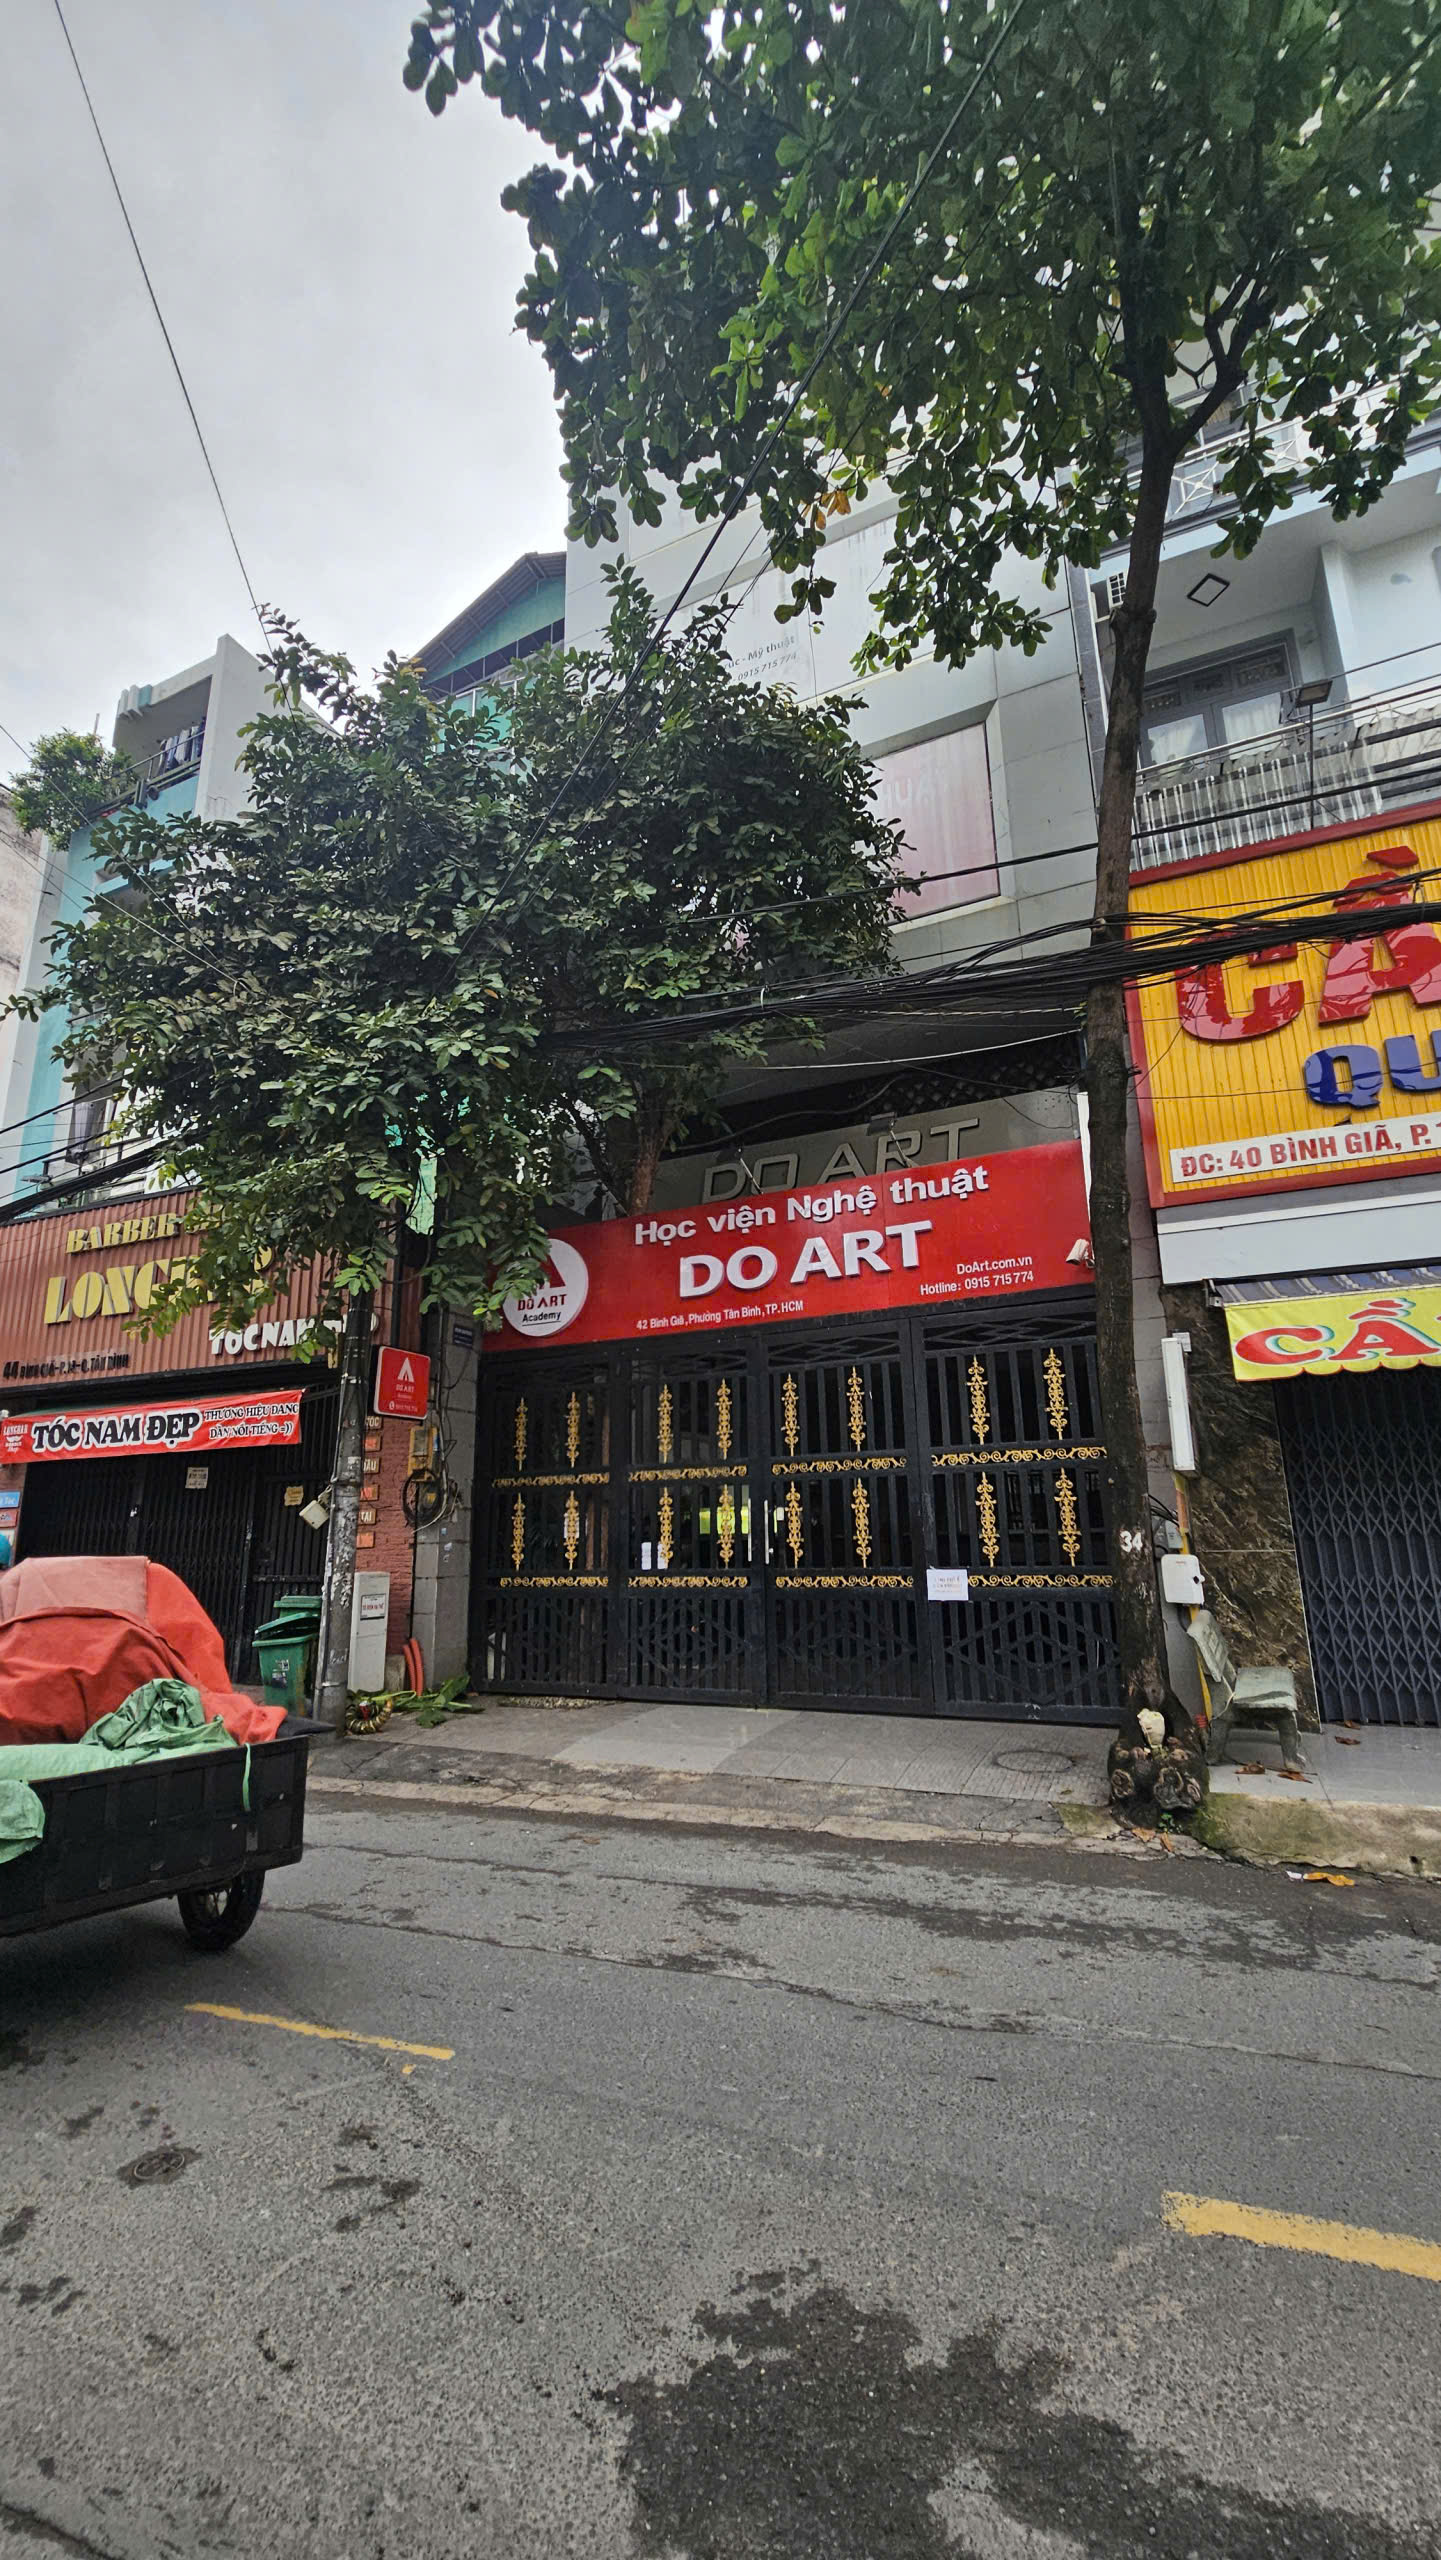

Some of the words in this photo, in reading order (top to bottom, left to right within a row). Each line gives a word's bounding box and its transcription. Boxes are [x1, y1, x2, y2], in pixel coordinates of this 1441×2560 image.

[816, 1117, 980, 1184] ART
[1180, 1154, 1224, 1178] ĐC:
[1230, 1147, 1263, 1170] 40
[1269, 1136, 1338, 1166] BÌNH
[1344, 1125, 1403, 1155] GIÃ,
[634, 1220, 697, 1247] Học
[706, 1206, 777, 1234] viện
[786, 1184, 878, 1223] Nghệ
[889, 1164, 990, 1204] thuật
[66, 1211, 181, 1254] BARBER
[679, 1244, 779, 1300] DO
[789, 1219, 934, 1285] ART
[956, 1255, 1033, 1275] DoArt.com.vn
[920, 1281, 962, 1296] Hotline:
[964, 1276, 991, 1290] 0915
[992, 1273, 1013, 1287] 715
[1013, 1270, 1035, 1284] 774
[517, 1299, 535, 1312] DO
[537, 1293, 568, 1309] ART
[521, 1311, 562, 1323] Academy
[636, 1319, 649, 1330] 42
[688, 1311, 721, 1325] Phường
[723, 1308, 740, 1320] Tân
[781, 1299, 804, 1313] HCM
[1235, 1299, 1441, 1365] CẦ
[3, 1360, 20, 1379] 44
[204, 1406, 244, 1421] THƯƠNG
[246, 1401, 270, 1419] HIỆU
[33, 1418, 81, 1450] TÓC
[84, 1417, 142, 1446] NAM
[146, 1412, 200, 1445] ĐẸP
[1119, 1530, 1144, 1553] 34
